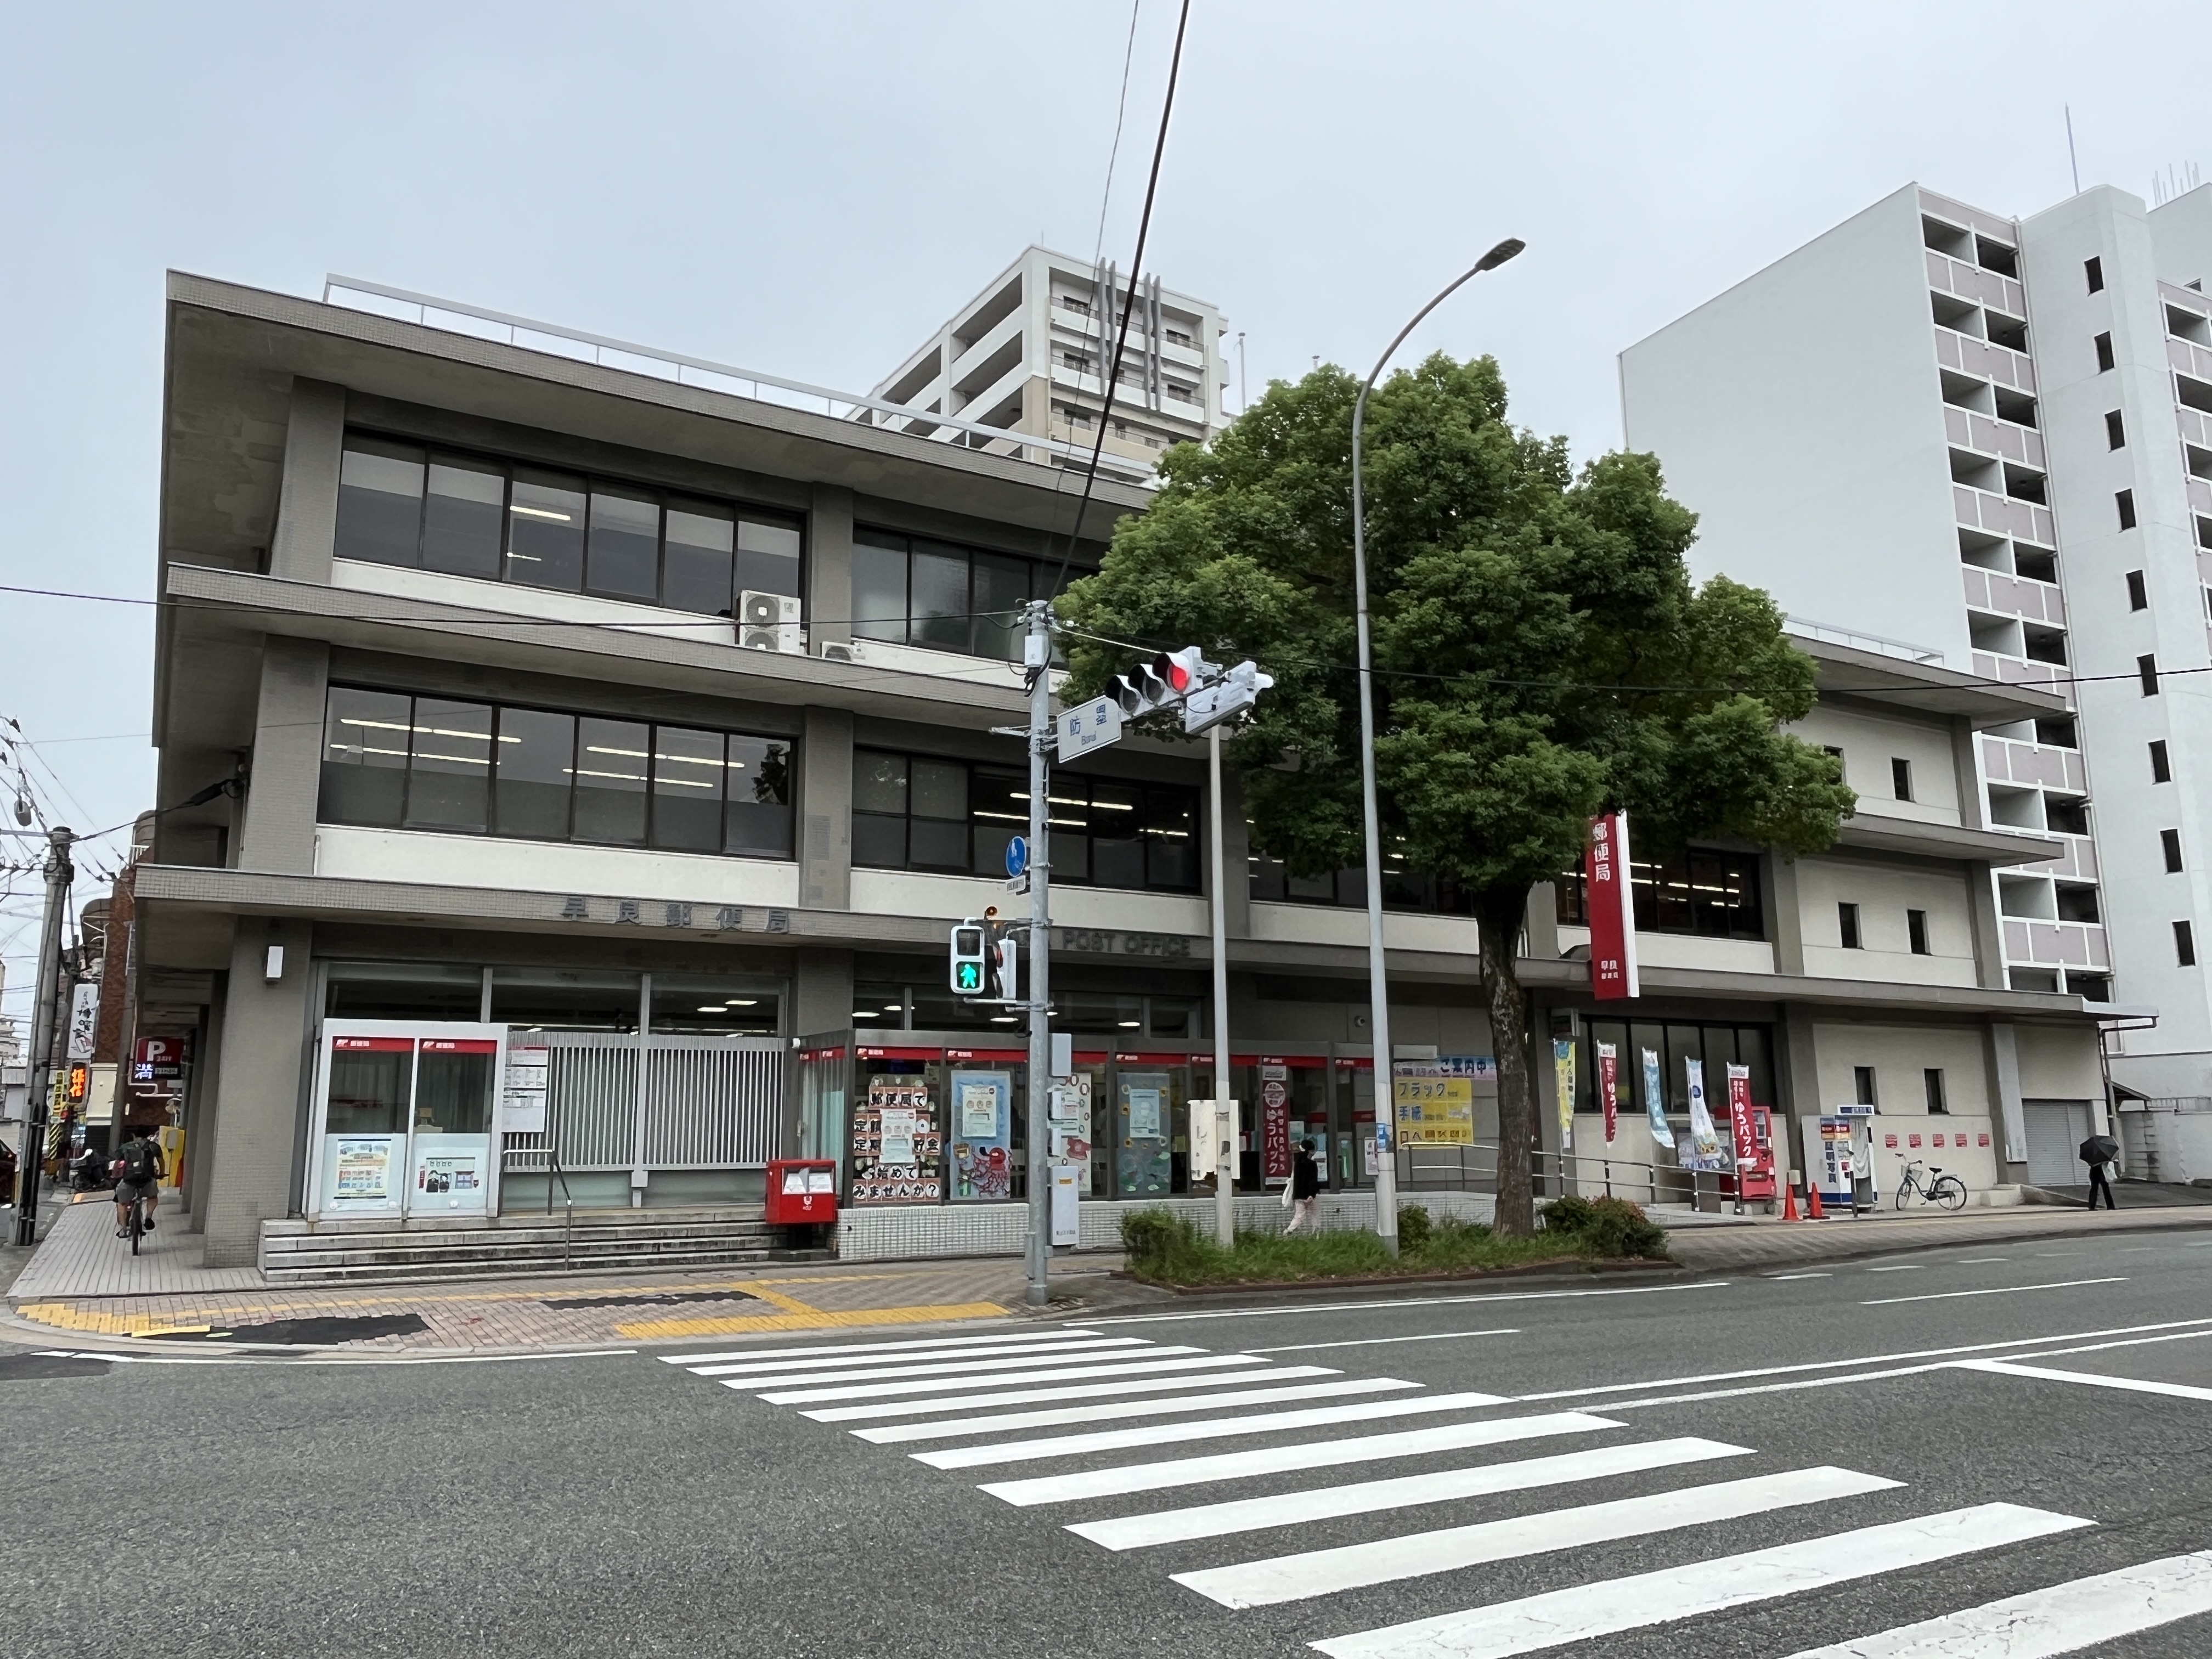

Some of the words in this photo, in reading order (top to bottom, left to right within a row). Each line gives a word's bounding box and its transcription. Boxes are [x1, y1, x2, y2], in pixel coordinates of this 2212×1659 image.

[1593, 822, 1611, 882] 郵便局
[560, 895, 789, 934] 早良郵便局
[1062, 930, 1116, 952] POST
[1125, 933, 1192, 957] OFFICE
[146, 1041, 166, 1062] P
[1735, 1102, 1752, 1156] ゆうパック
